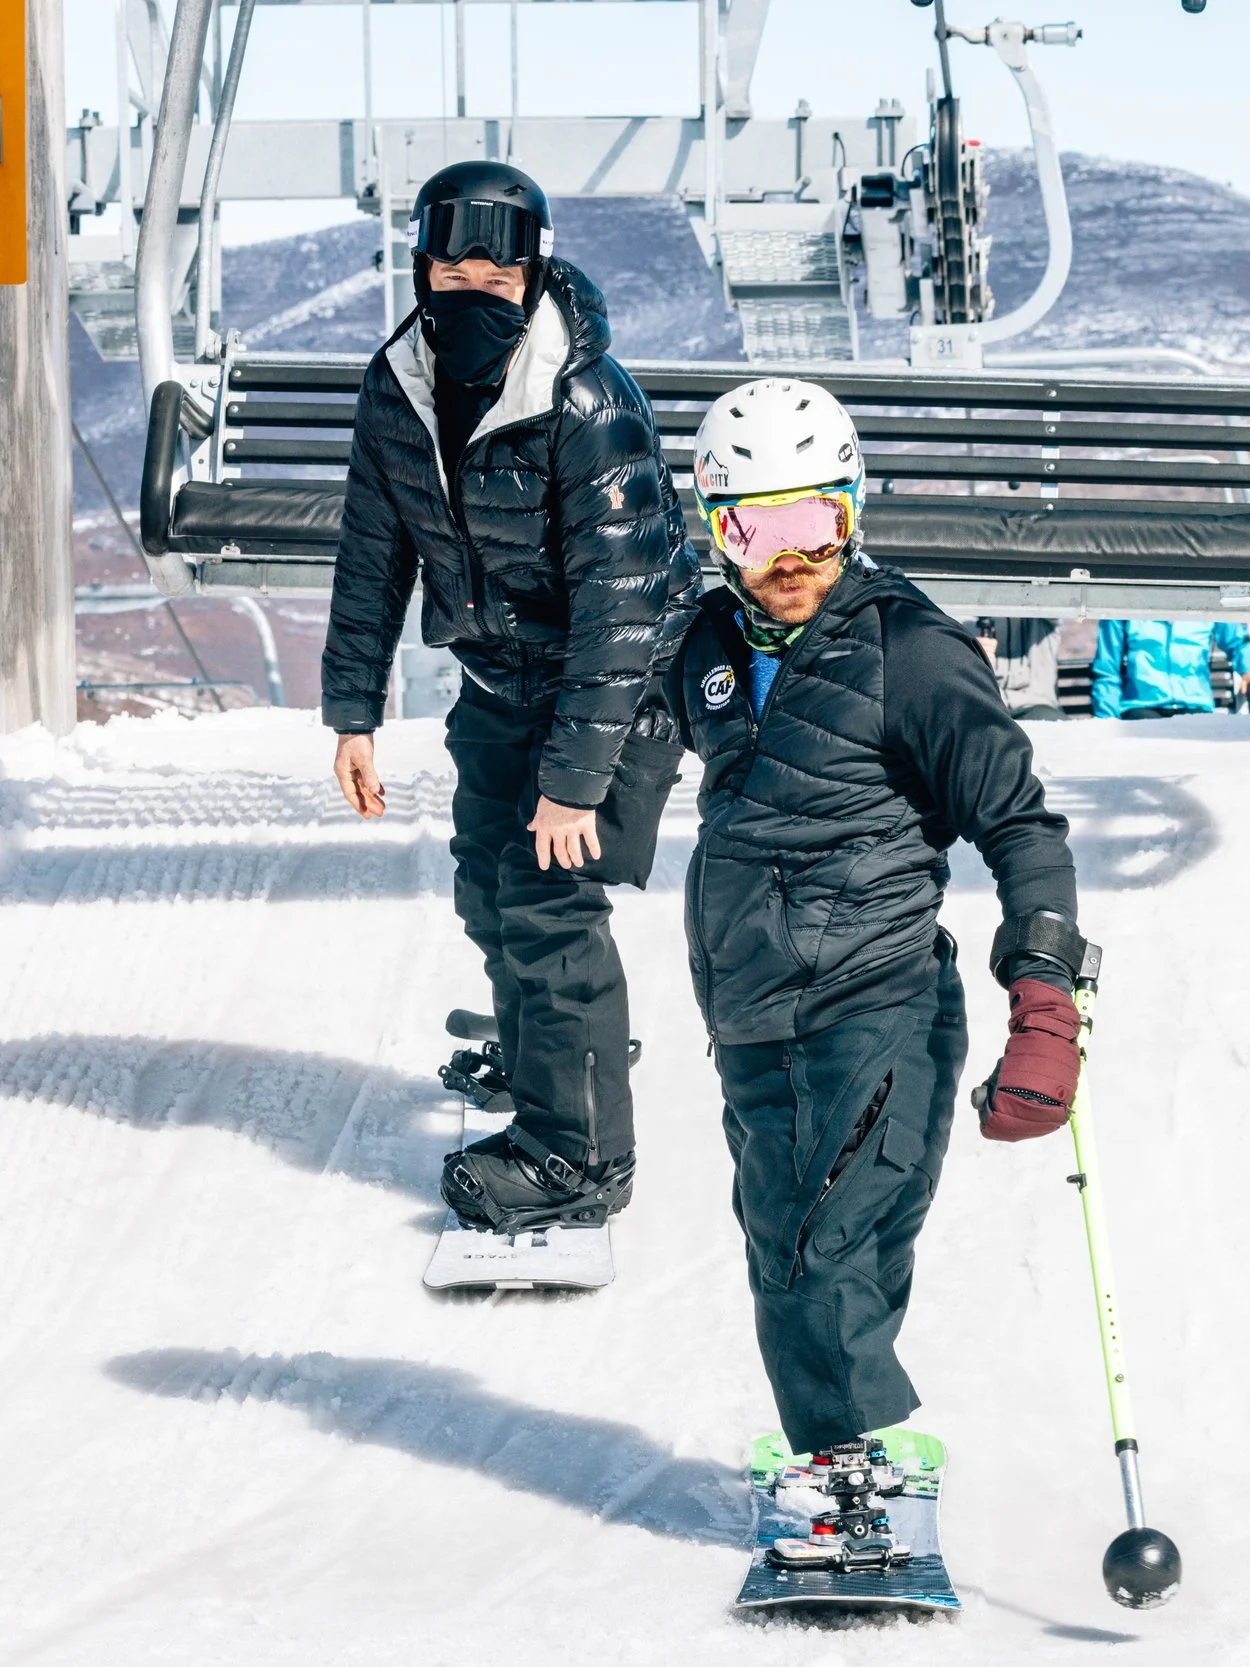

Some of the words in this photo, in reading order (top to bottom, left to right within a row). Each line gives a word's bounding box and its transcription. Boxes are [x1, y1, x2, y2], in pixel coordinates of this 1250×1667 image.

[937, 339, 953, 354] 31
[710, 473, 729, 487] CITY
[707, 680, 732, 697] CAF
